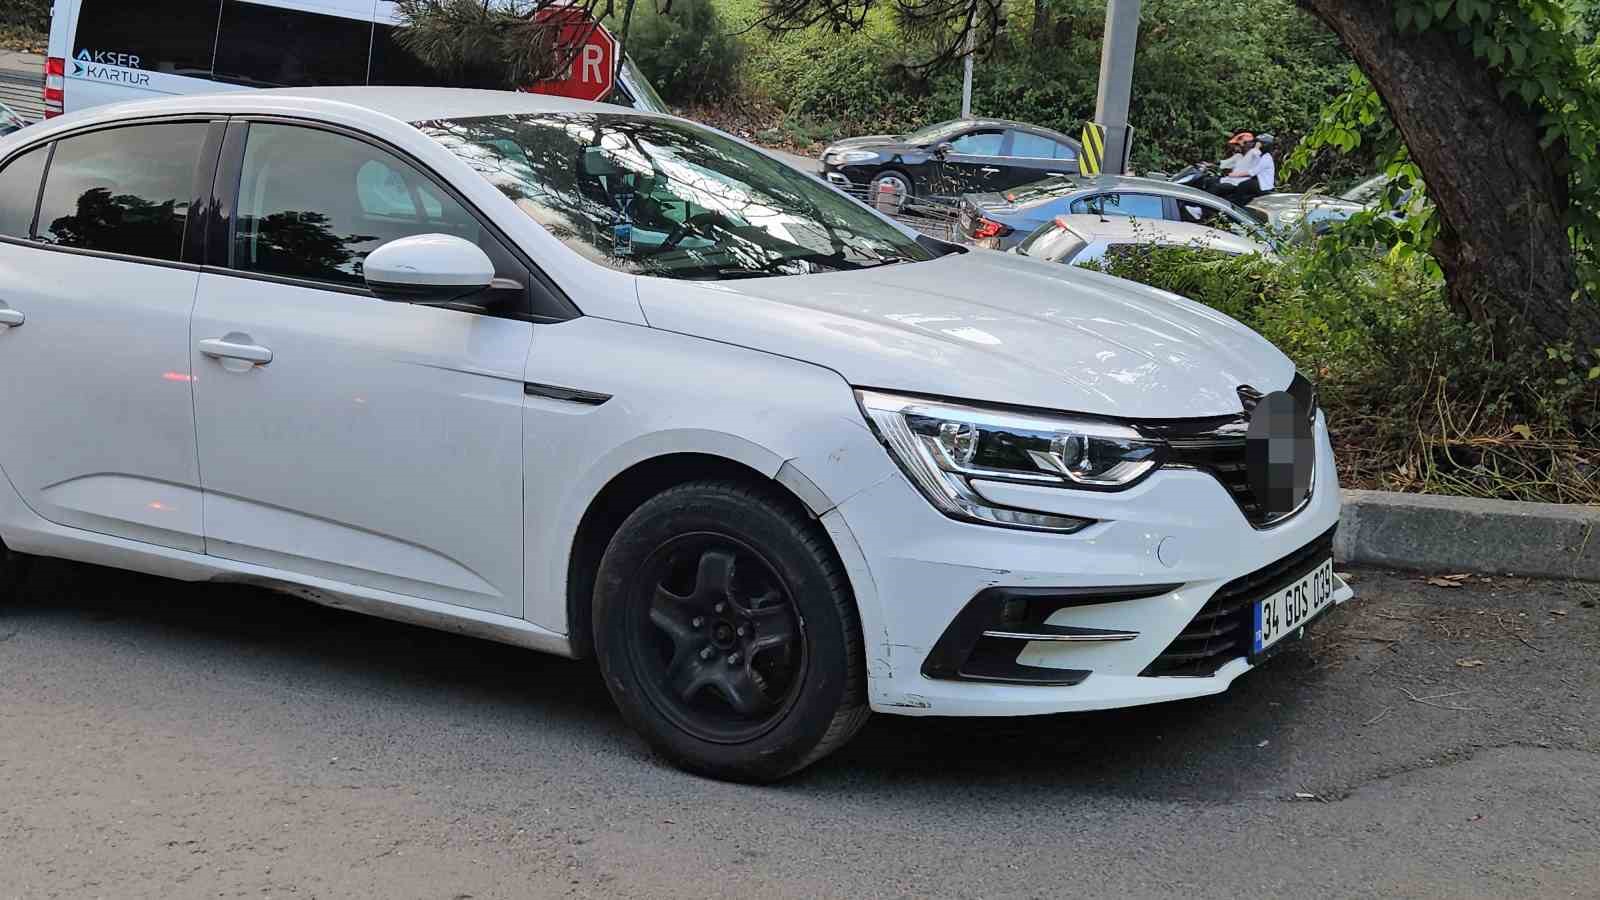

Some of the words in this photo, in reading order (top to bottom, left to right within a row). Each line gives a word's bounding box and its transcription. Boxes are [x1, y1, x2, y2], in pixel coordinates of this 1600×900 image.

[77, 48, 140, 68] AKSER
[87, 65, 150, 86] KARTUR
[1263, 599, 1279, 640] 34
[1285, 580, 1309, 627] GDS
[1313, 563, 1331, 609] 039
